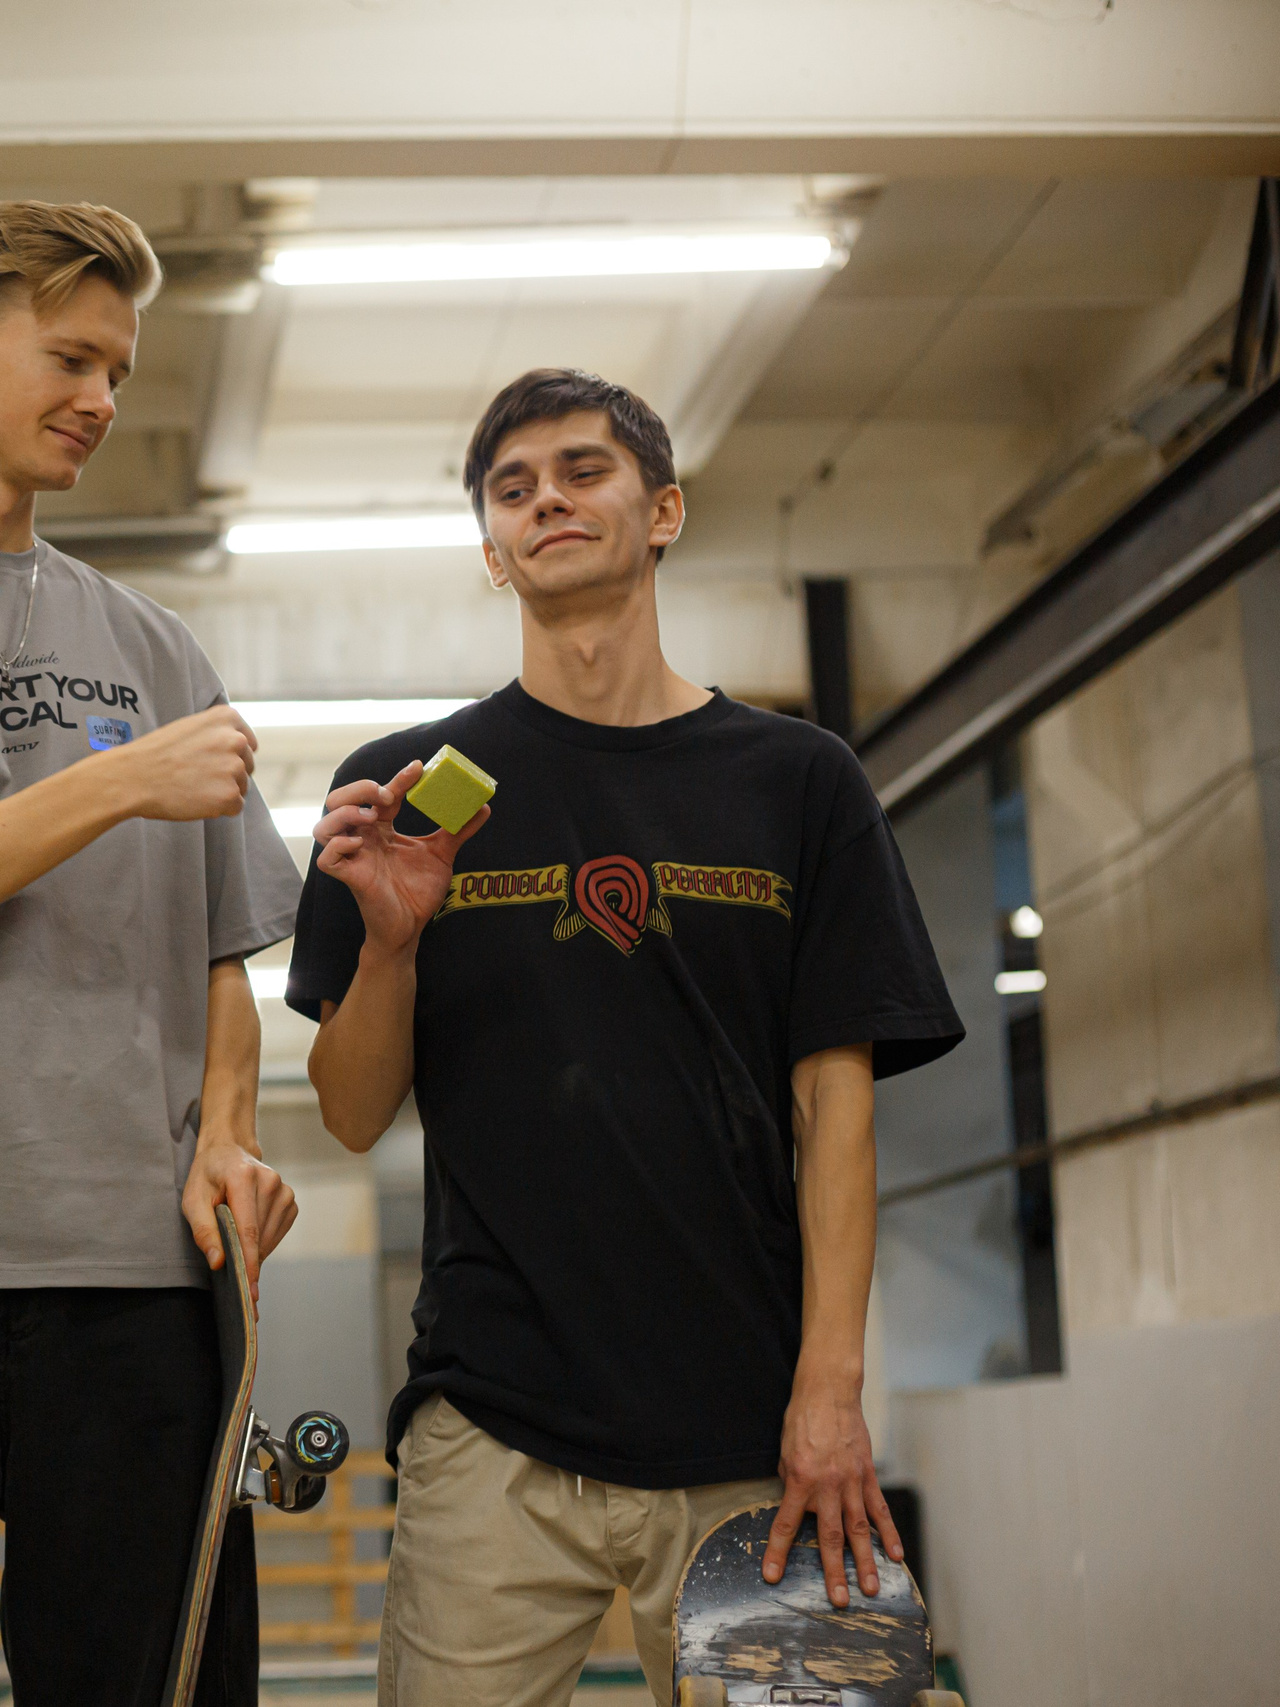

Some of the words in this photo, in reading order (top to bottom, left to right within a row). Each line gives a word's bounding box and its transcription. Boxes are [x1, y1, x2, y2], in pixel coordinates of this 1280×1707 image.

[45, 671, 139, 714] YOUR
[460, 868, 563, 903] POWELL
[658, 863, 771, 902] PERALTA
